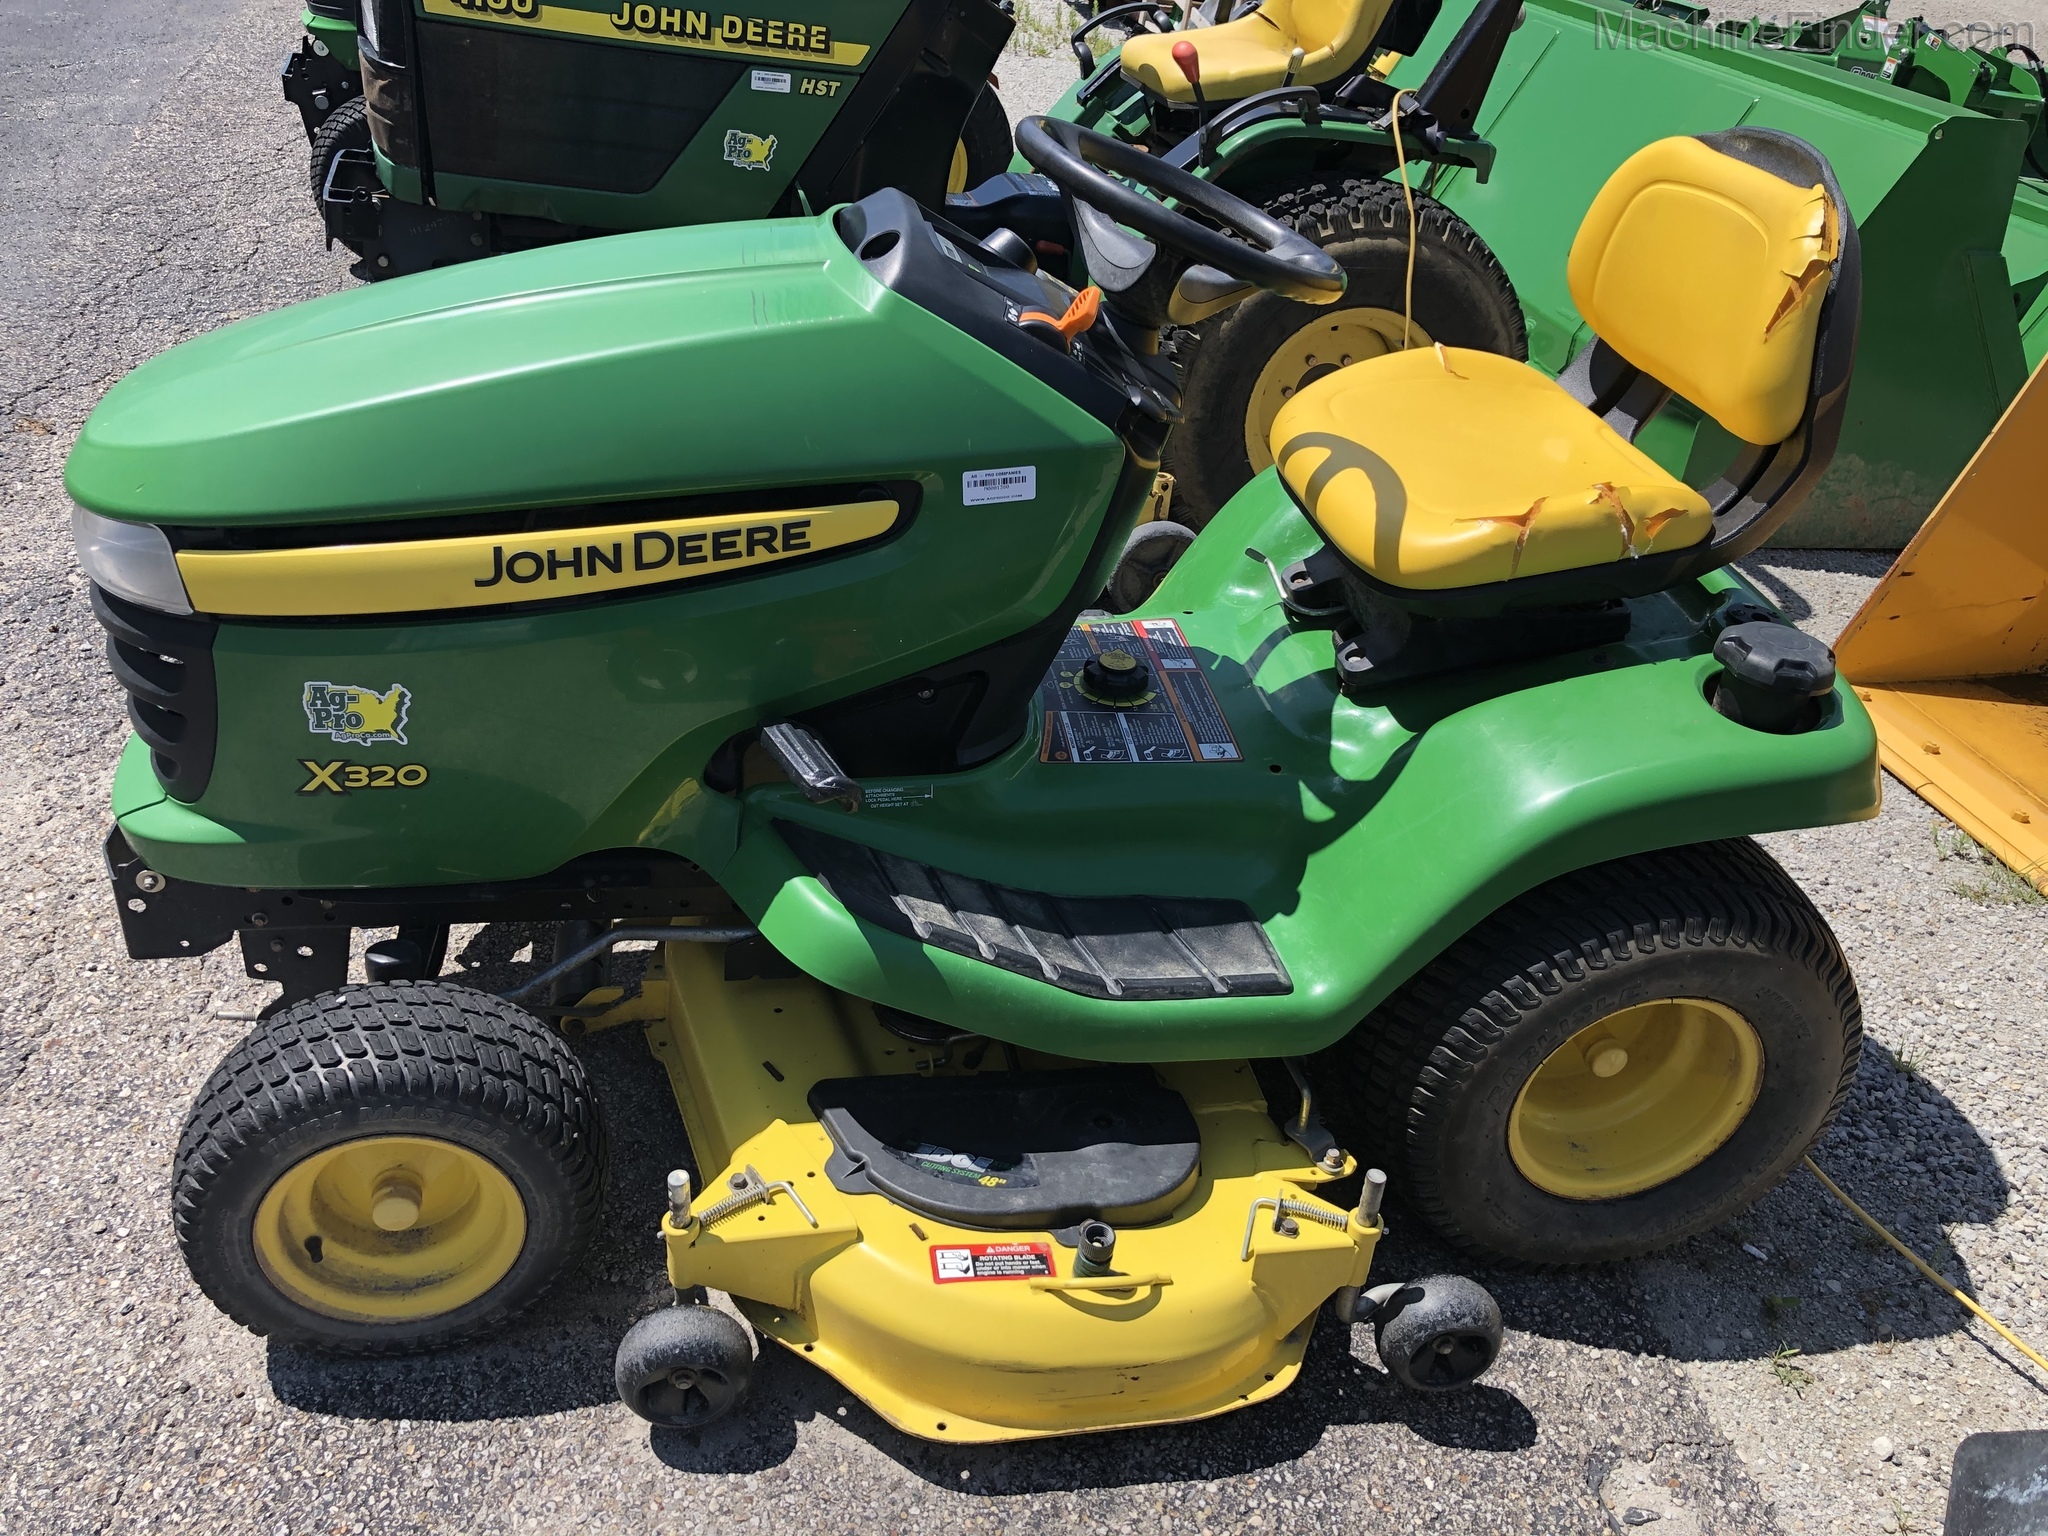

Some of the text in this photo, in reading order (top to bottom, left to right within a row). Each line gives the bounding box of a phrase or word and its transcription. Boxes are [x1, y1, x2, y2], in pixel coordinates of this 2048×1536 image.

[610, 2, 829, 51] JOHN DEERE
[799, 77, 841, 97] HST
[727, 146, 752, 158] Pro
[474, 518, 812, 588] JOHN DEERE
[312, 707, 364, 730] Pro
[335, 732, 391, 740] AgProCo.com
[299, 760, 429, 793] X320
[358, 1103, 511, 1145] MASTER
[920, 1161, 1008, 1187] CUTTING SYSTEM 48"
[995, 1245, 1031, 1253] DANGER
